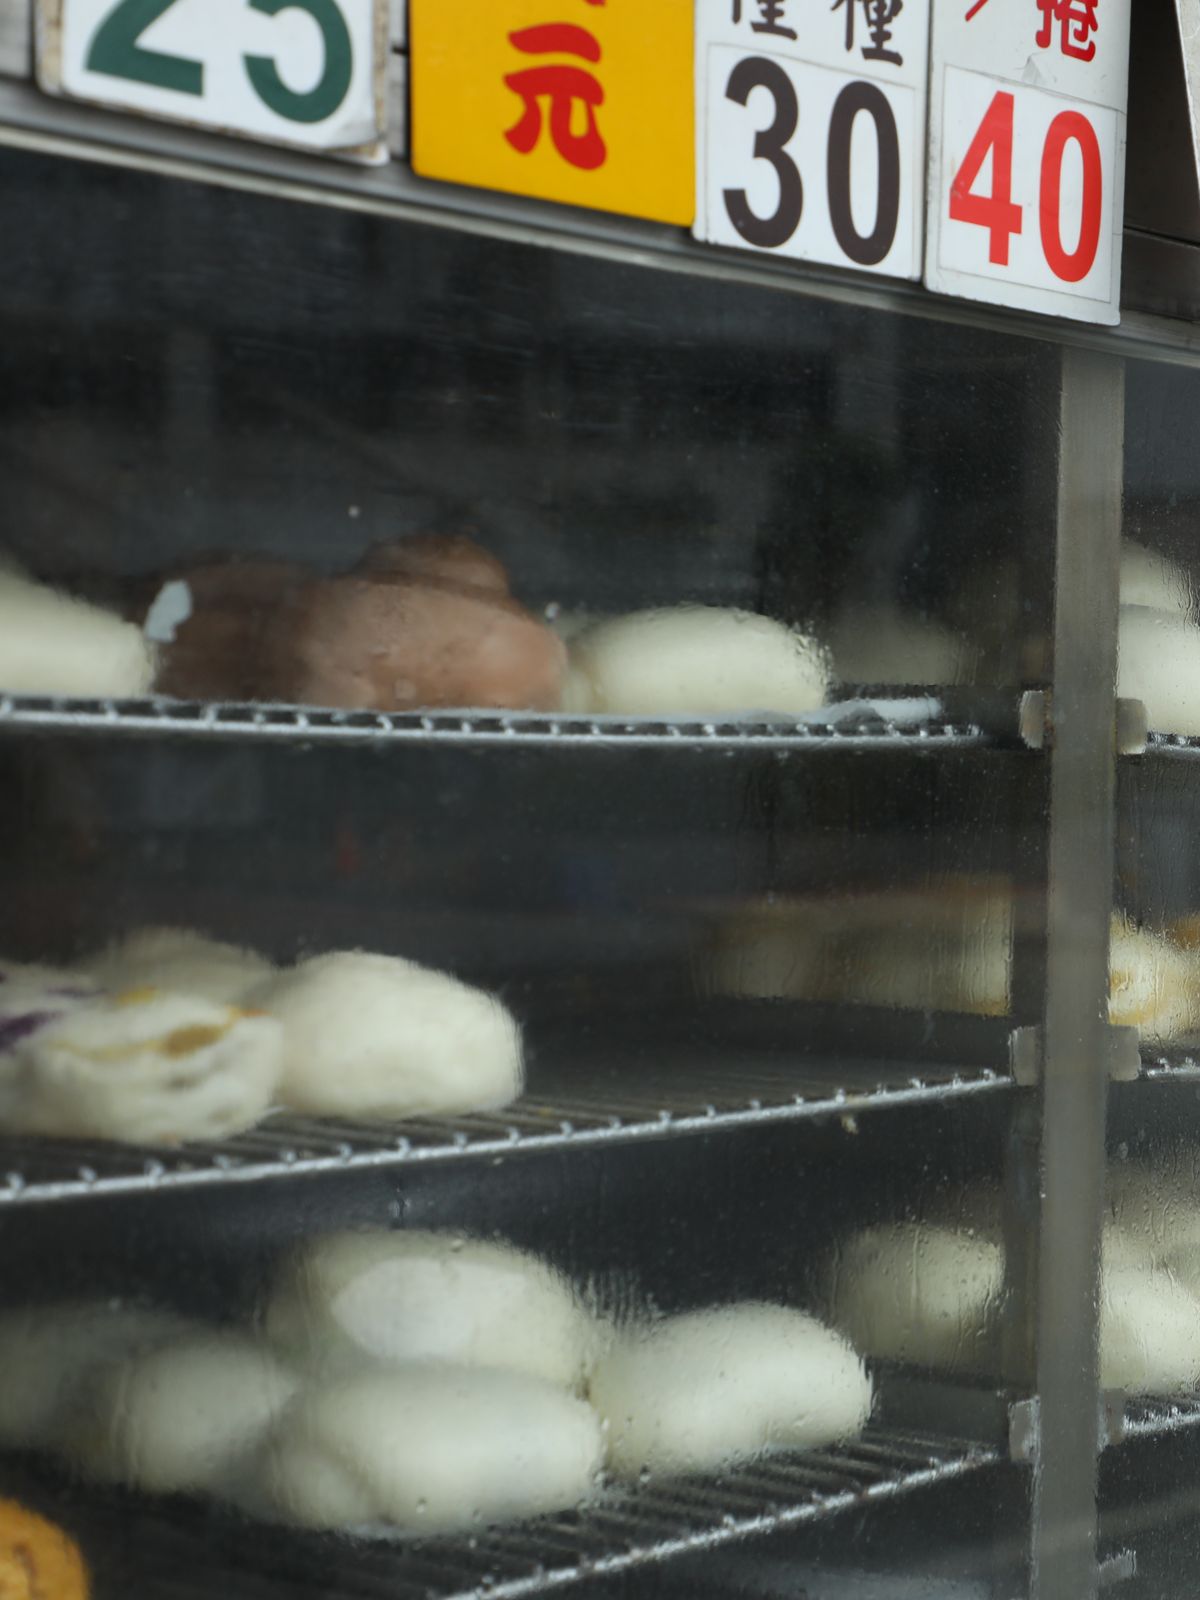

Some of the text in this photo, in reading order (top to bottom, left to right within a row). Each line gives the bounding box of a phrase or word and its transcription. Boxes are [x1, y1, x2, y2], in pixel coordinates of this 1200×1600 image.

[503, 22, 607, 171] 元
[722, 56, 900, 266] 30
[949, 90, 1102, 283] 40
